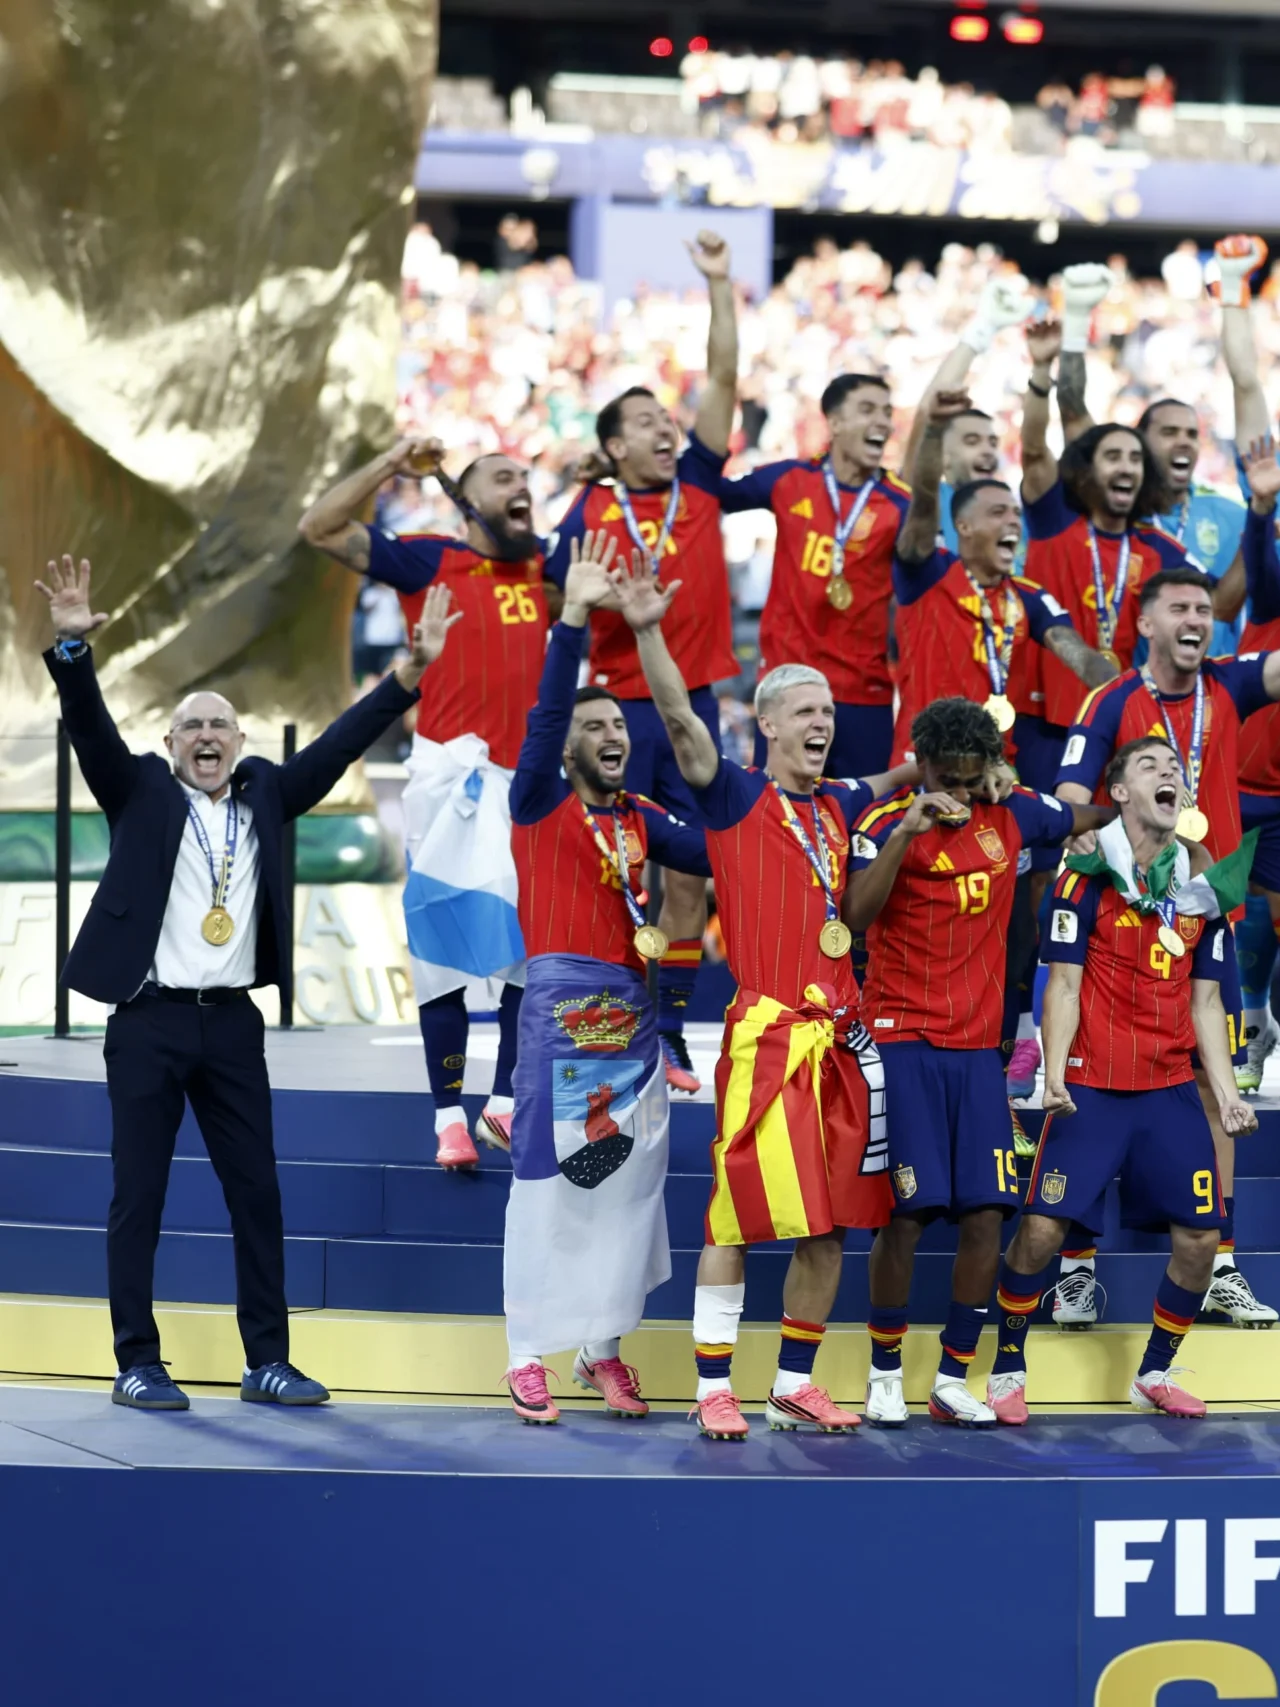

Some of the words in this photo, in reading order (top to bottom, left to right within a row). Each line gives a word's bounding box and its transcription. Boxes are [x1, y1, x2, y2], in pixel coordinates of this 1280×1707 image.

[493, 584, 540, 625] 26
[955, 872, 990, 914] 19
[1150, 943, 1171, 980] 9
[993, 1148, 1018, 1194] 19
[1192, 1169, 1214, 1215] 9
